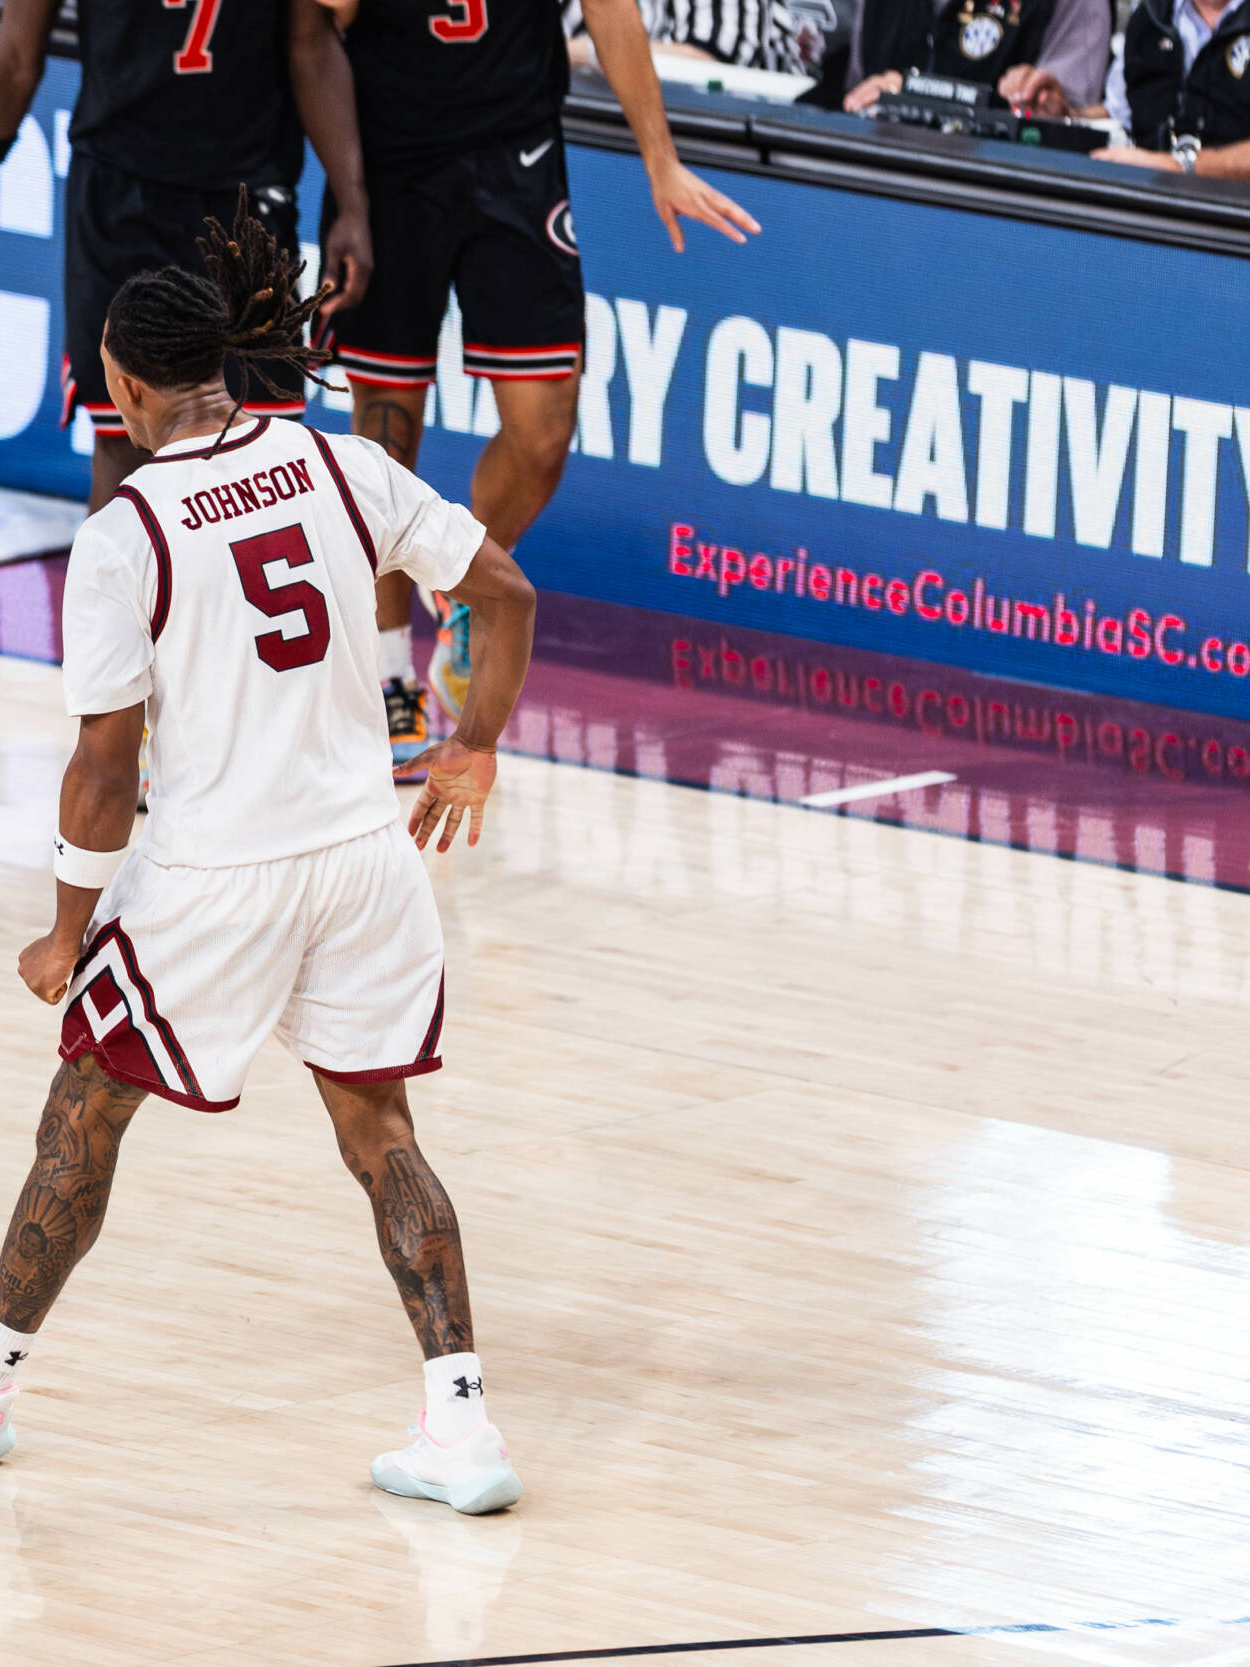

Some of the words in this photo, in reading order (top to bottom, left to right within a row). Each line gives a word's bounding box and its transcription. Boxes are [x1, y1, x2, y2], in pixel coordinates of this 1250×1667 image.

[164, 0, 221, 74] 7
[181, 458, 315, 531] JOHNSON
[702, 313, 1250, 575] CREATIVIT
[228, 522, 331, 673] 5
[668, 520, 1250, 678] ExperienceColumbiaSC.co
